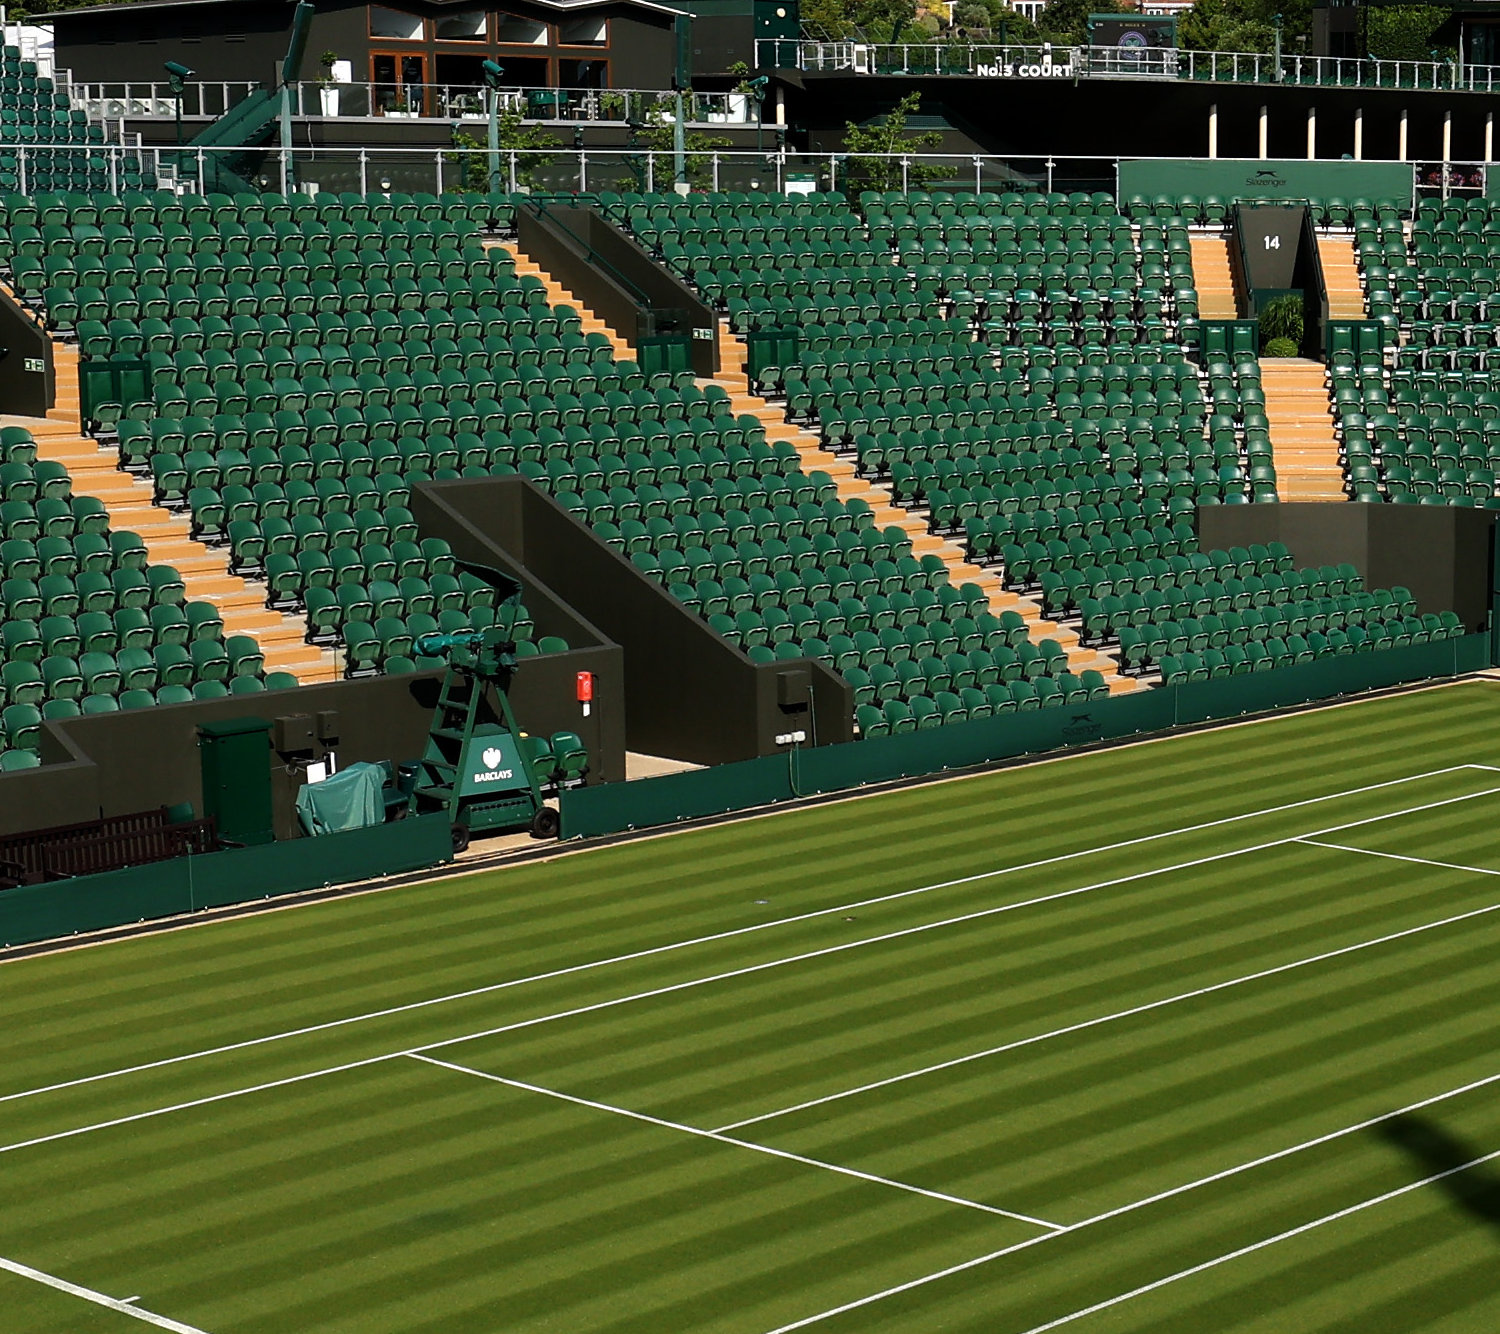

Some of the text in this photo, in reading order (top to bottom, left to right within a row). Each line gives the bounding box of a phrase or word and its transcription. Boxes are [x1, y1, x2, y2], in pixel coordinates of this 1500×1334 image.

[1018, 64, 1071, 77] COURT
[1264, 235, 1280, 250] 14
[474, 769, 512, 783] BARCLAYS
